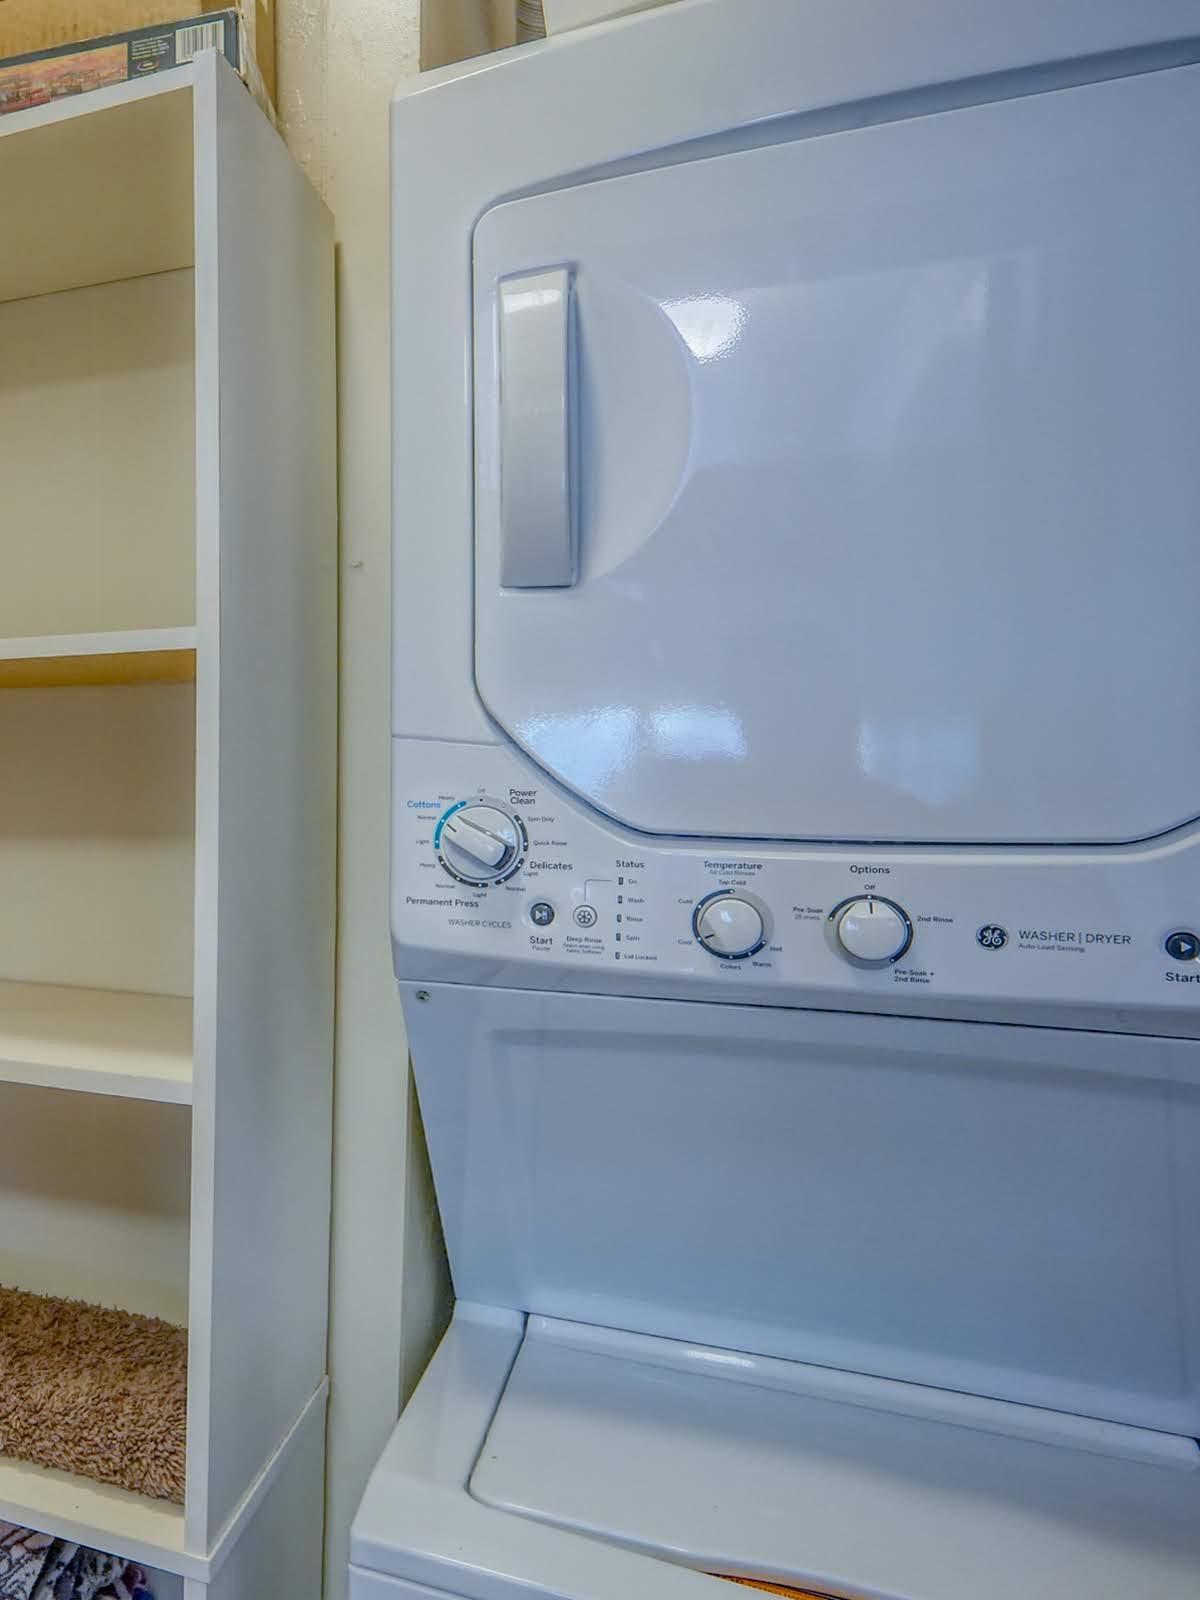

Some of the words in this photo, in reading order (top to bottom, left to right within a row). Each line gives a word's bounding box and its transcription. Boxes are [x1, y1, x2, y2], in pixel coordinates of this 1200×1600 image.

[509, 789, 537, 798] Power
[407, 800, 441, 809] Cottons
[510, 797, 536, 805] Clean
[530, 861, 573, 871] Delicates
[615, 860, 645, 868] Status
[704, 861, 763, 871] Temperature
[849, 865, 891, 875] Options
[406, 896, 453, 906] Permanent
[454, 898, 480, 908] Press
[448, 919, 480, 927] WASHER
[481, 920, 512, 929] CYCLES
[916, 915, 931, 923] 2nd
[529, 936, 554, 945] Start
[1018, 930, 1075, 942] WASHER
[1085, 933, 1132, 945] DRYER
[1165, 972, 1200, 983] Start
